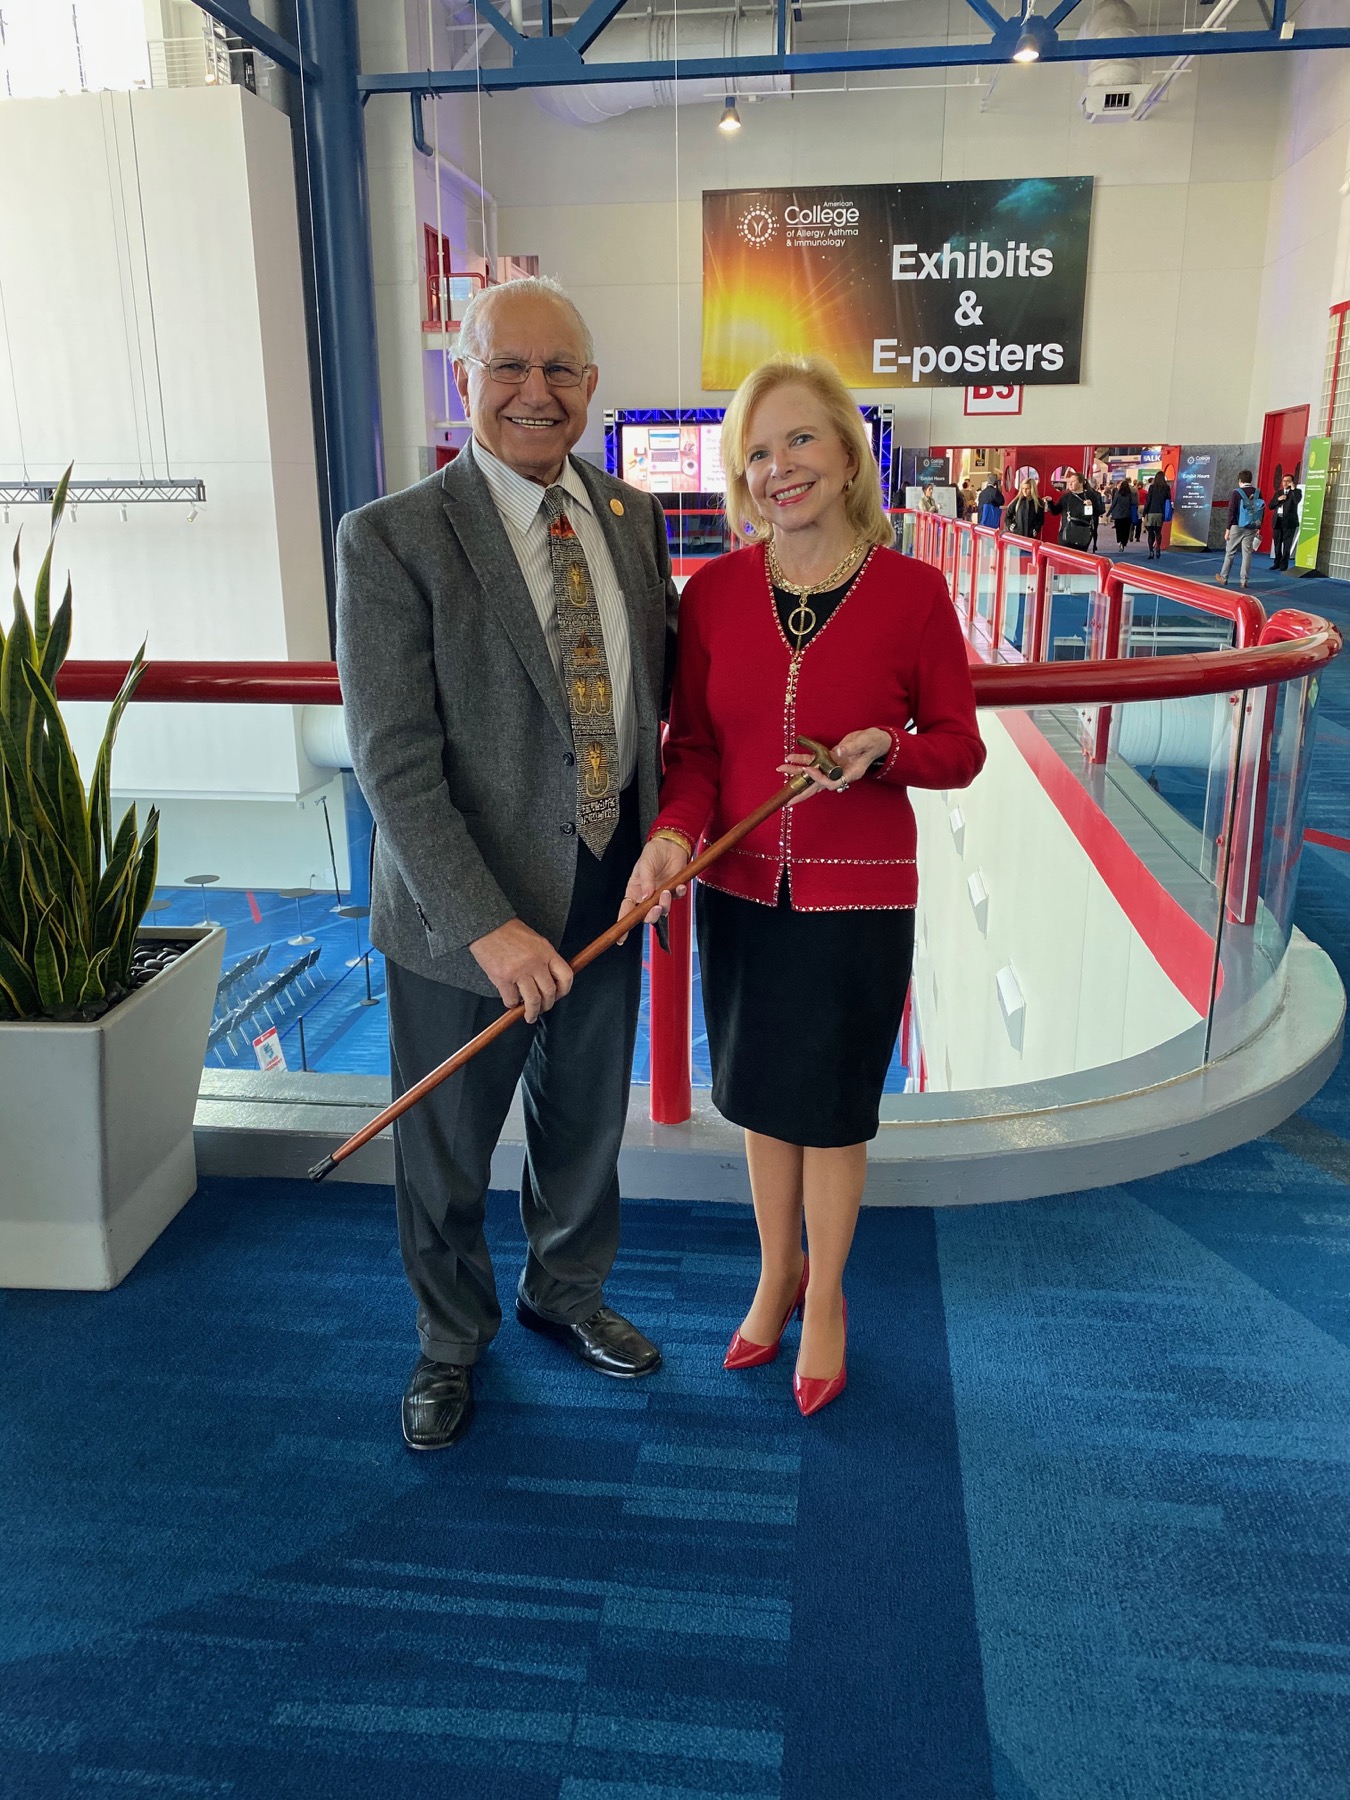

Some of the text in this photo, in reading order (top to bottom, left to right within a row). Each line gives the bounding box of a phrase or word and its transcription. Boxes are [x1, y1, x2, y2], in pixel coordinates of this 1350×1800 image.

[784, 205, 860, 227] College
[786, 228, 859, 239] of Allergy, Asthma
[786, 238, 846, 248] & Immunology
[892, 240, 1054, 281] Exhibits
[954, 290, 984, 327] &
[872, 338, 1065, 383] E-posters
